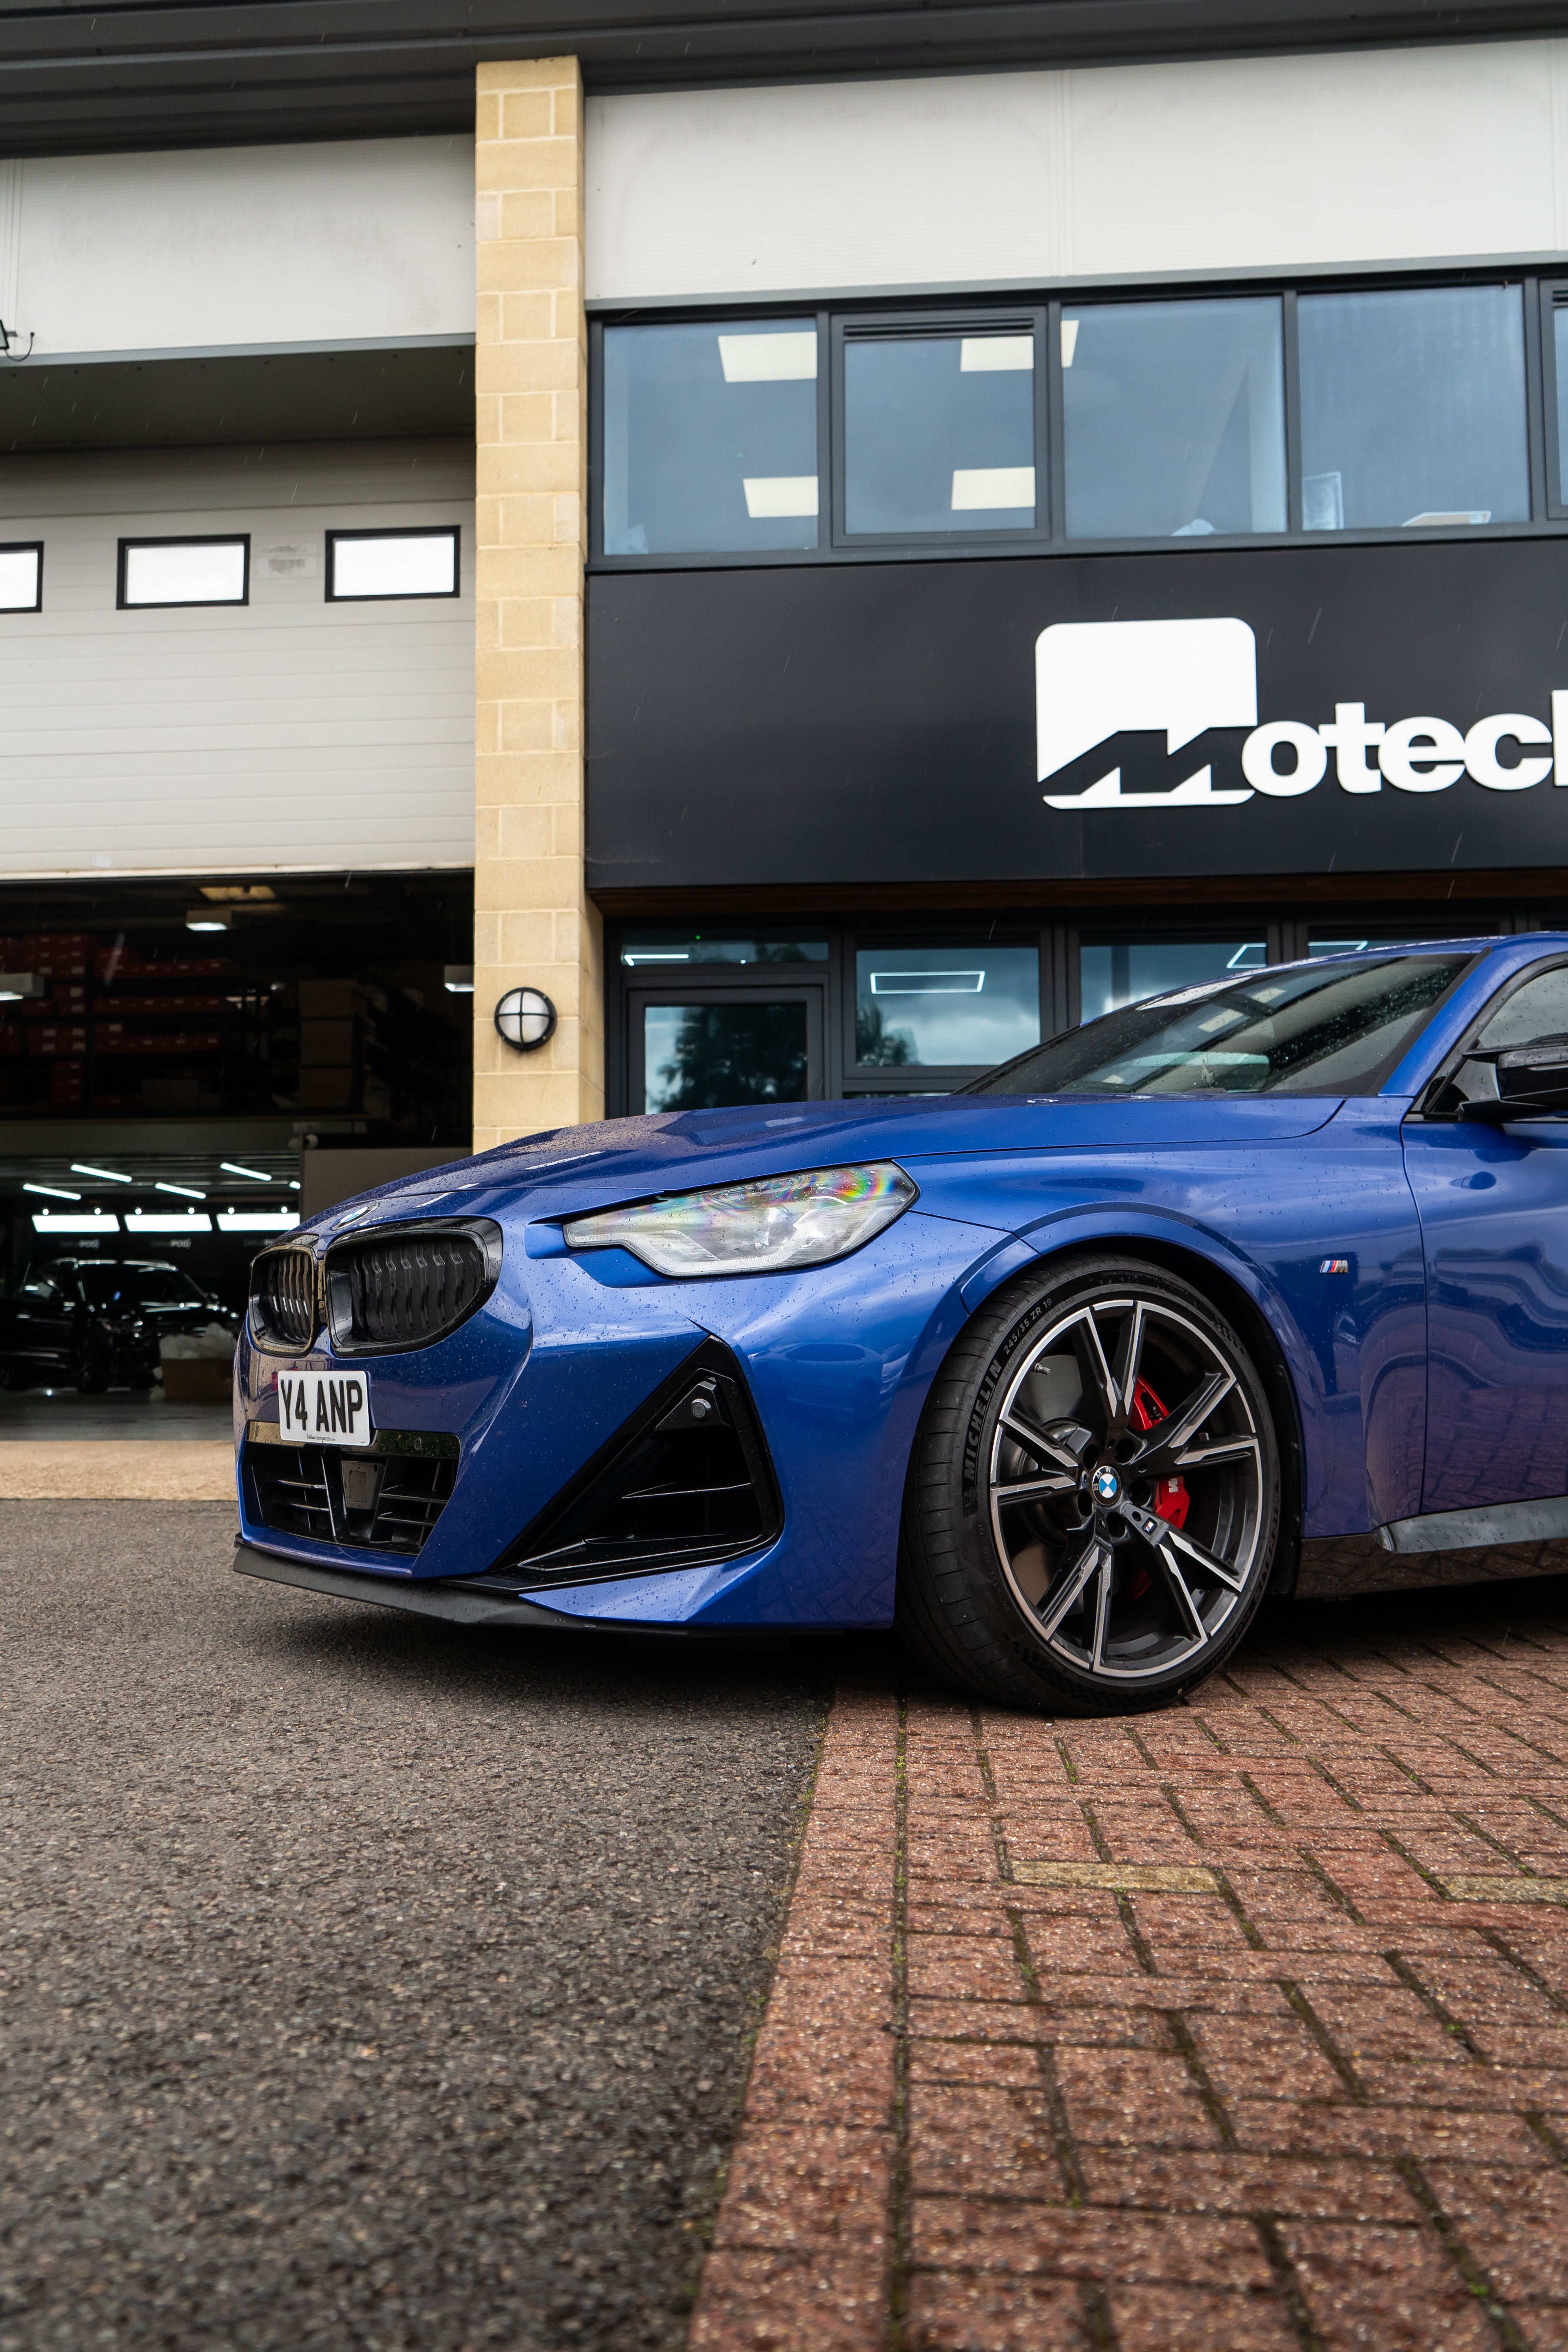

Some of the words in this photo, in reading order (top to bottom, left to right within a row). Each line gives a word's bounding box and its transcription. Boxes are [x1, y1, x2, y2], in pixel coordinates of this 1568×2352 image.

[280, 1379, 307, 1430] Y4
[316, 1380, 363, 1433] ANP
[964, 1358, 1002, 1481] MICHELIN
[1003, 1318, 1030, 1355] 245/35
[1029, 1306, 1042, 1321] ZR
[1042, 1297, 1053, 1309] 19
[1093, 1467, 1111, 1490] BMW
